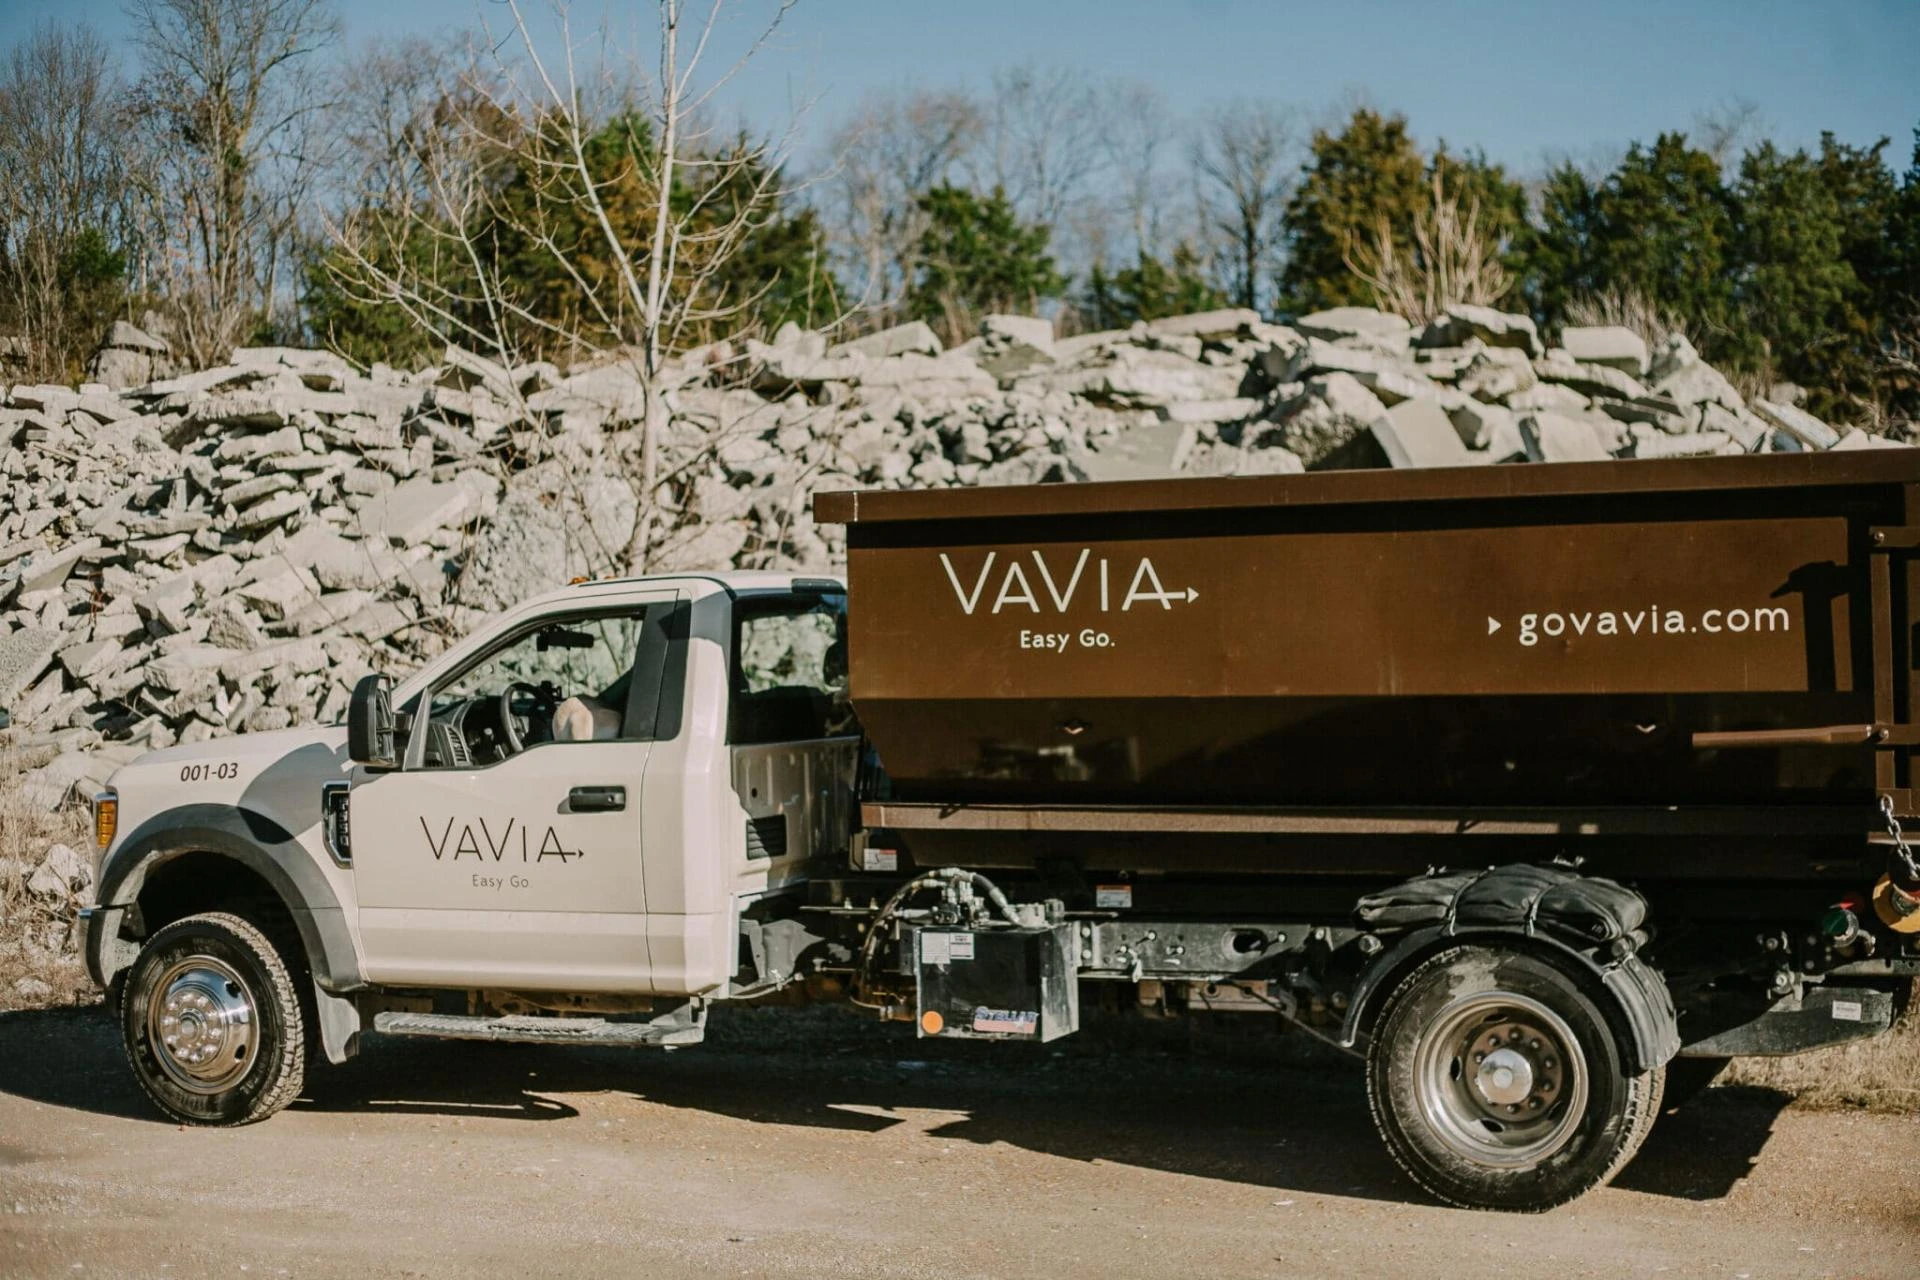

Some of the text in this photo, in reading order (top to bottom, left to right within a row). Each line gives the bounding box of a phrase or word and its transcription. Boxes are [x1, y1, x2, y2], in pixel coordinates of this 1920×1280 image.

[939, 548, 1187, 614] VAVIA
[1020, 628, 1115, 653] Easy Go.
[1519, 604, 1789, 646] govavia.com
[180, 762, 239, 782] 001-03
[420, 816, 577, 863] VAVIA
[472, 874, 503, 891] Easy
